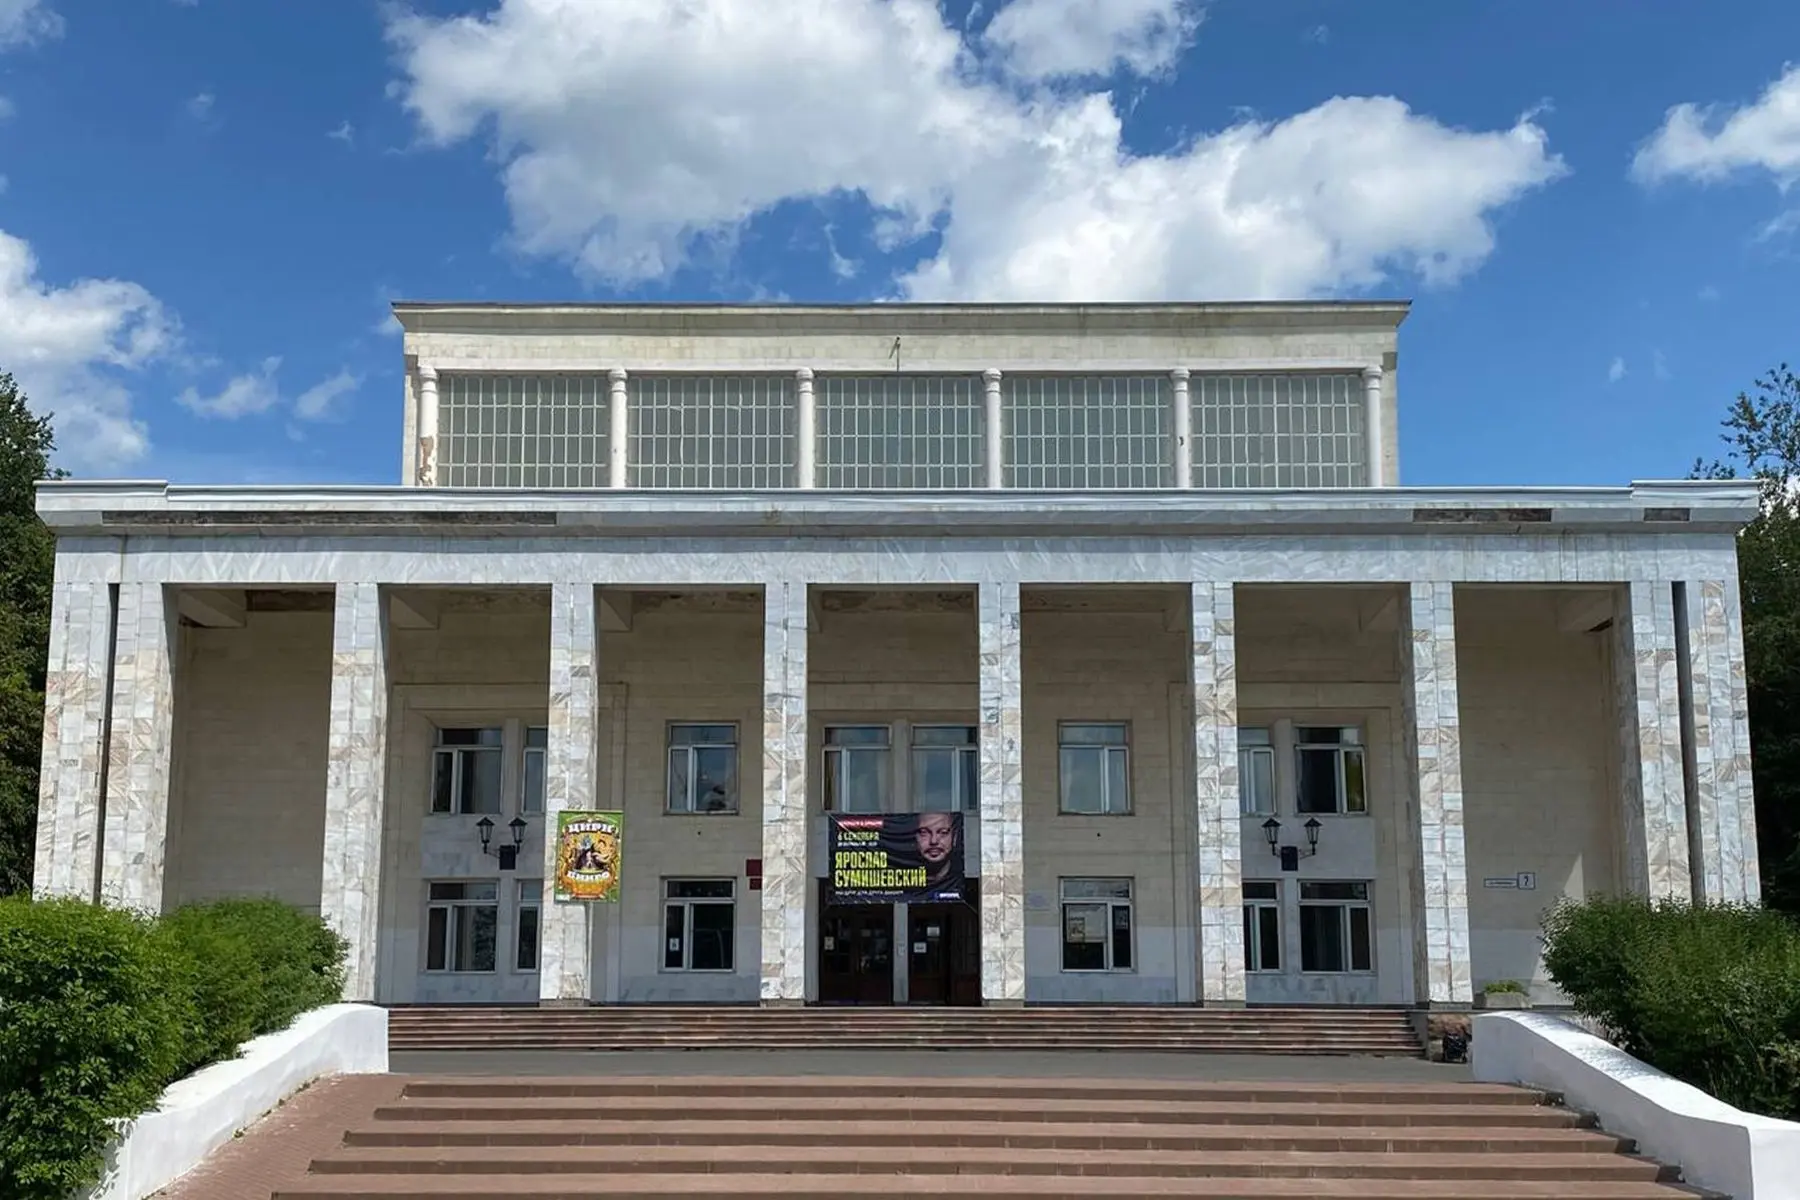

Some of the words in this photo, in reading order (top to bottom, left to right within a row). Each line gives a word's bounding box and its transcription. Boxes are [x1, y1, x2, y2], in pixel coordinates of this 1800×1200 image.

[567, 822, 615, 833] ЦИРК
[835, 851, 888, 869] ЯРОСЛАВ
[834, 866, 927, 888] СУМИШЕВСКИЙ
